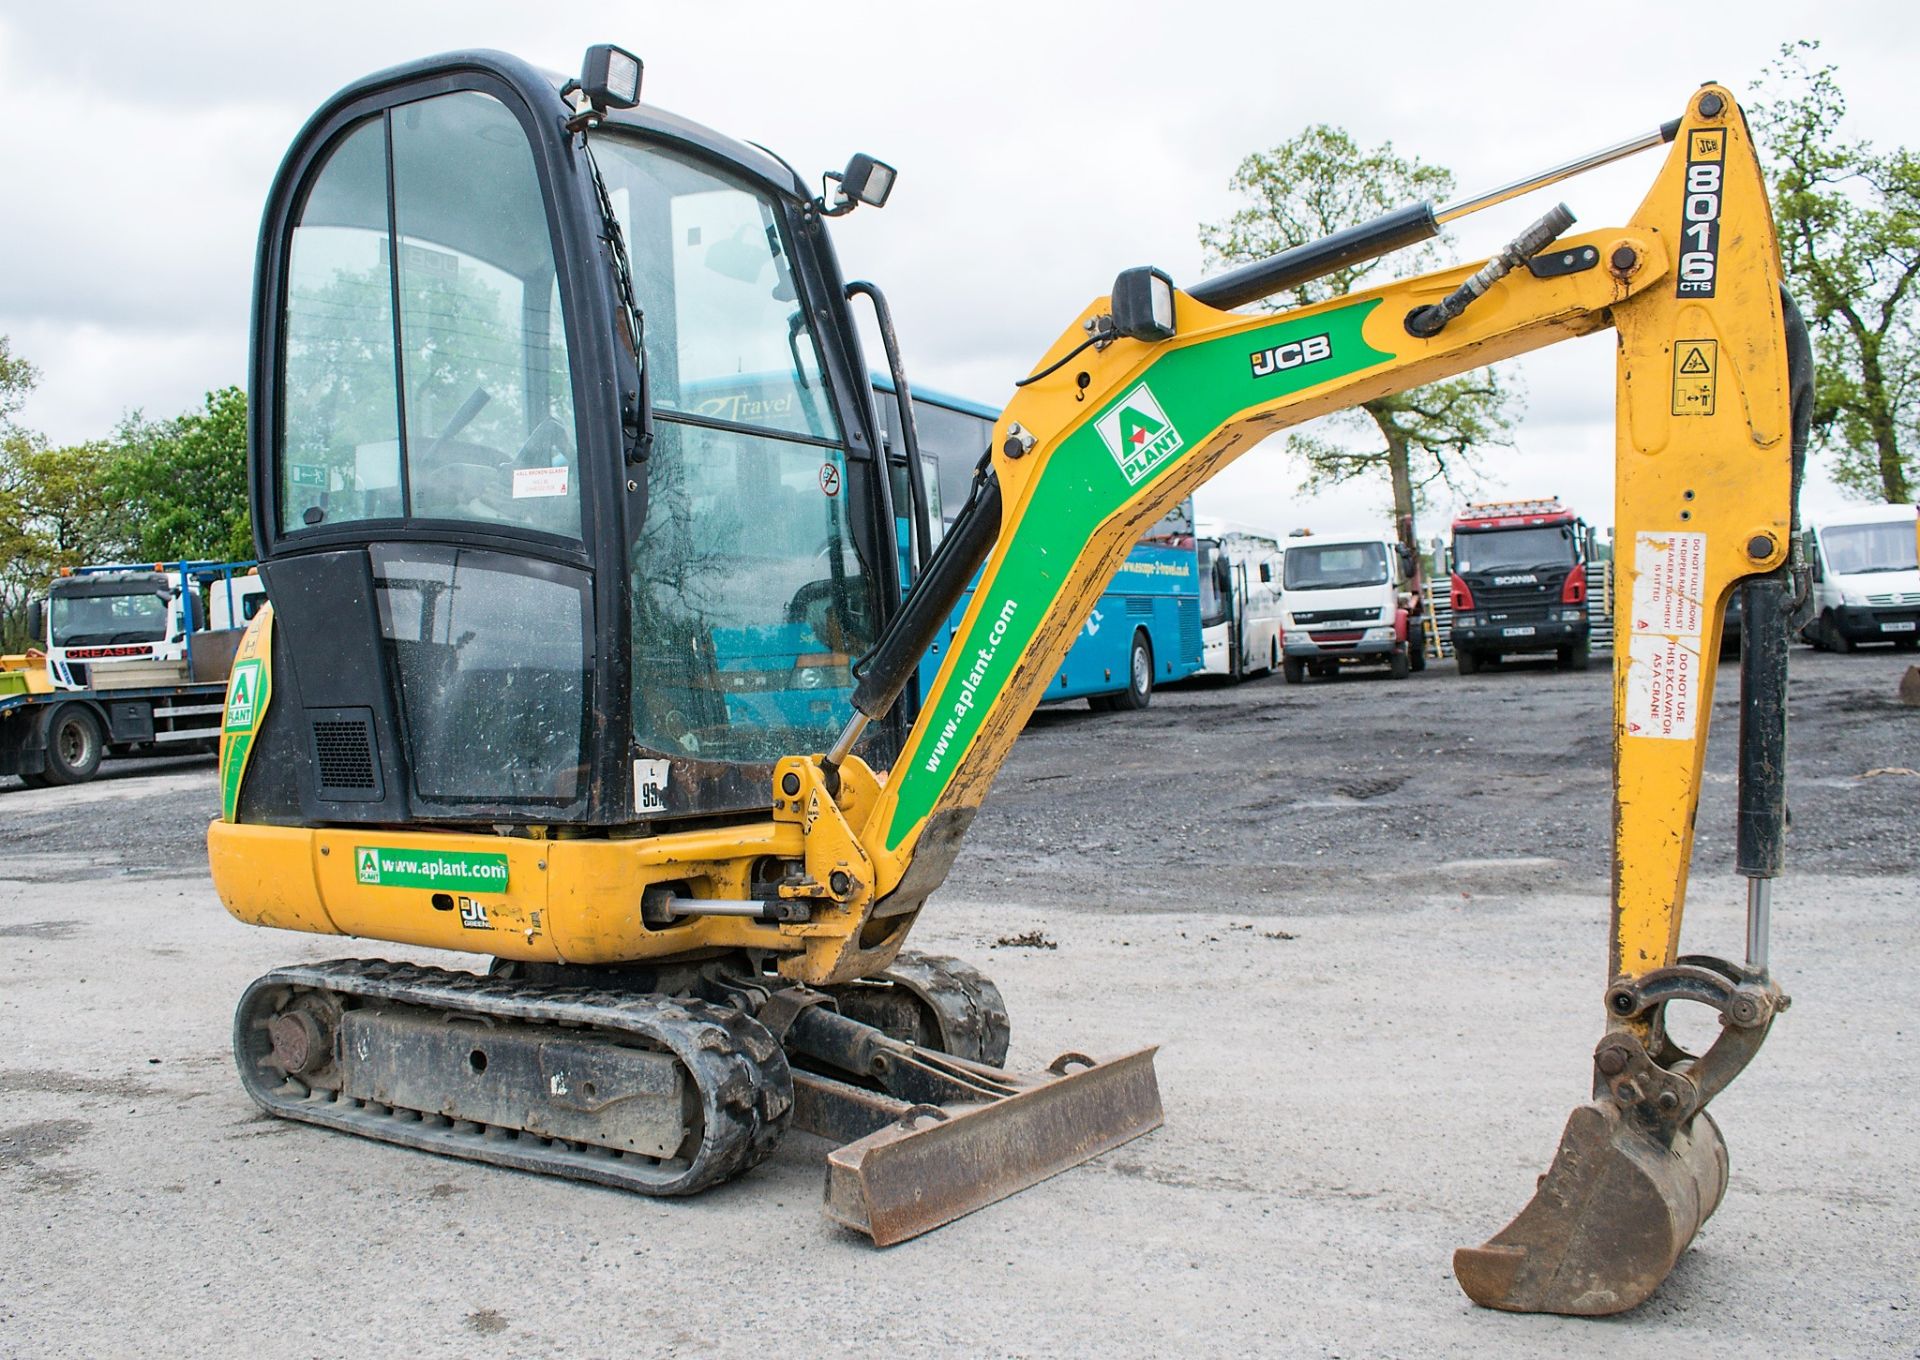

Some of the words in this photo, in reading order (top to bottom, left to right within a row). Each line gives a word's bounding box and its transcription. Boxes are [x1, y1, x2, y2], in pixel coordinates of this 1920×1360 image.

[1700, 139, 1718, 153] JCB
[1681, 164, 1720, 281] 8016
[1679, 281, 1711, 292] CTS
[1252, 336, 1331, 376] JCB
[1119, 406, 1165, 460] A
[1124, 430, 1178, 480] PLANT
[1681, 538, 1688, 547] IN
[1693, 538, 1700, 551] DO
[1494, 575, 1537, 585] SCANIA
[1653, 573, 1661, 602] FITTED
[1690, 573, 1699, 596] FULLY
[1664, 576, 1674, 629] ATTACHMENT
[1676, 599, 1684, 629] WHILST
[67, 646, 149, 659] CREASEY
[1653, 653, 1662, 668] AS
[1667, 641, 1675, 665] THIS
[1679, 653, 1688, 670] DO
[1653, 670, 1661, 678] A
[231, 673, 250, 705] A
[925, 599, 1018, 773] www.aplant.com
[1678, 674, 1687, 698] NOT
[1651, 681, 1661, 719] CRANE
[1663, 669, 1675, 734] EXCAVATOR
[1677, 702, 1686, 723] USE
[361, 872, 379, 880] PLANT
[382, 858, 506, 880] www.aplant.com
